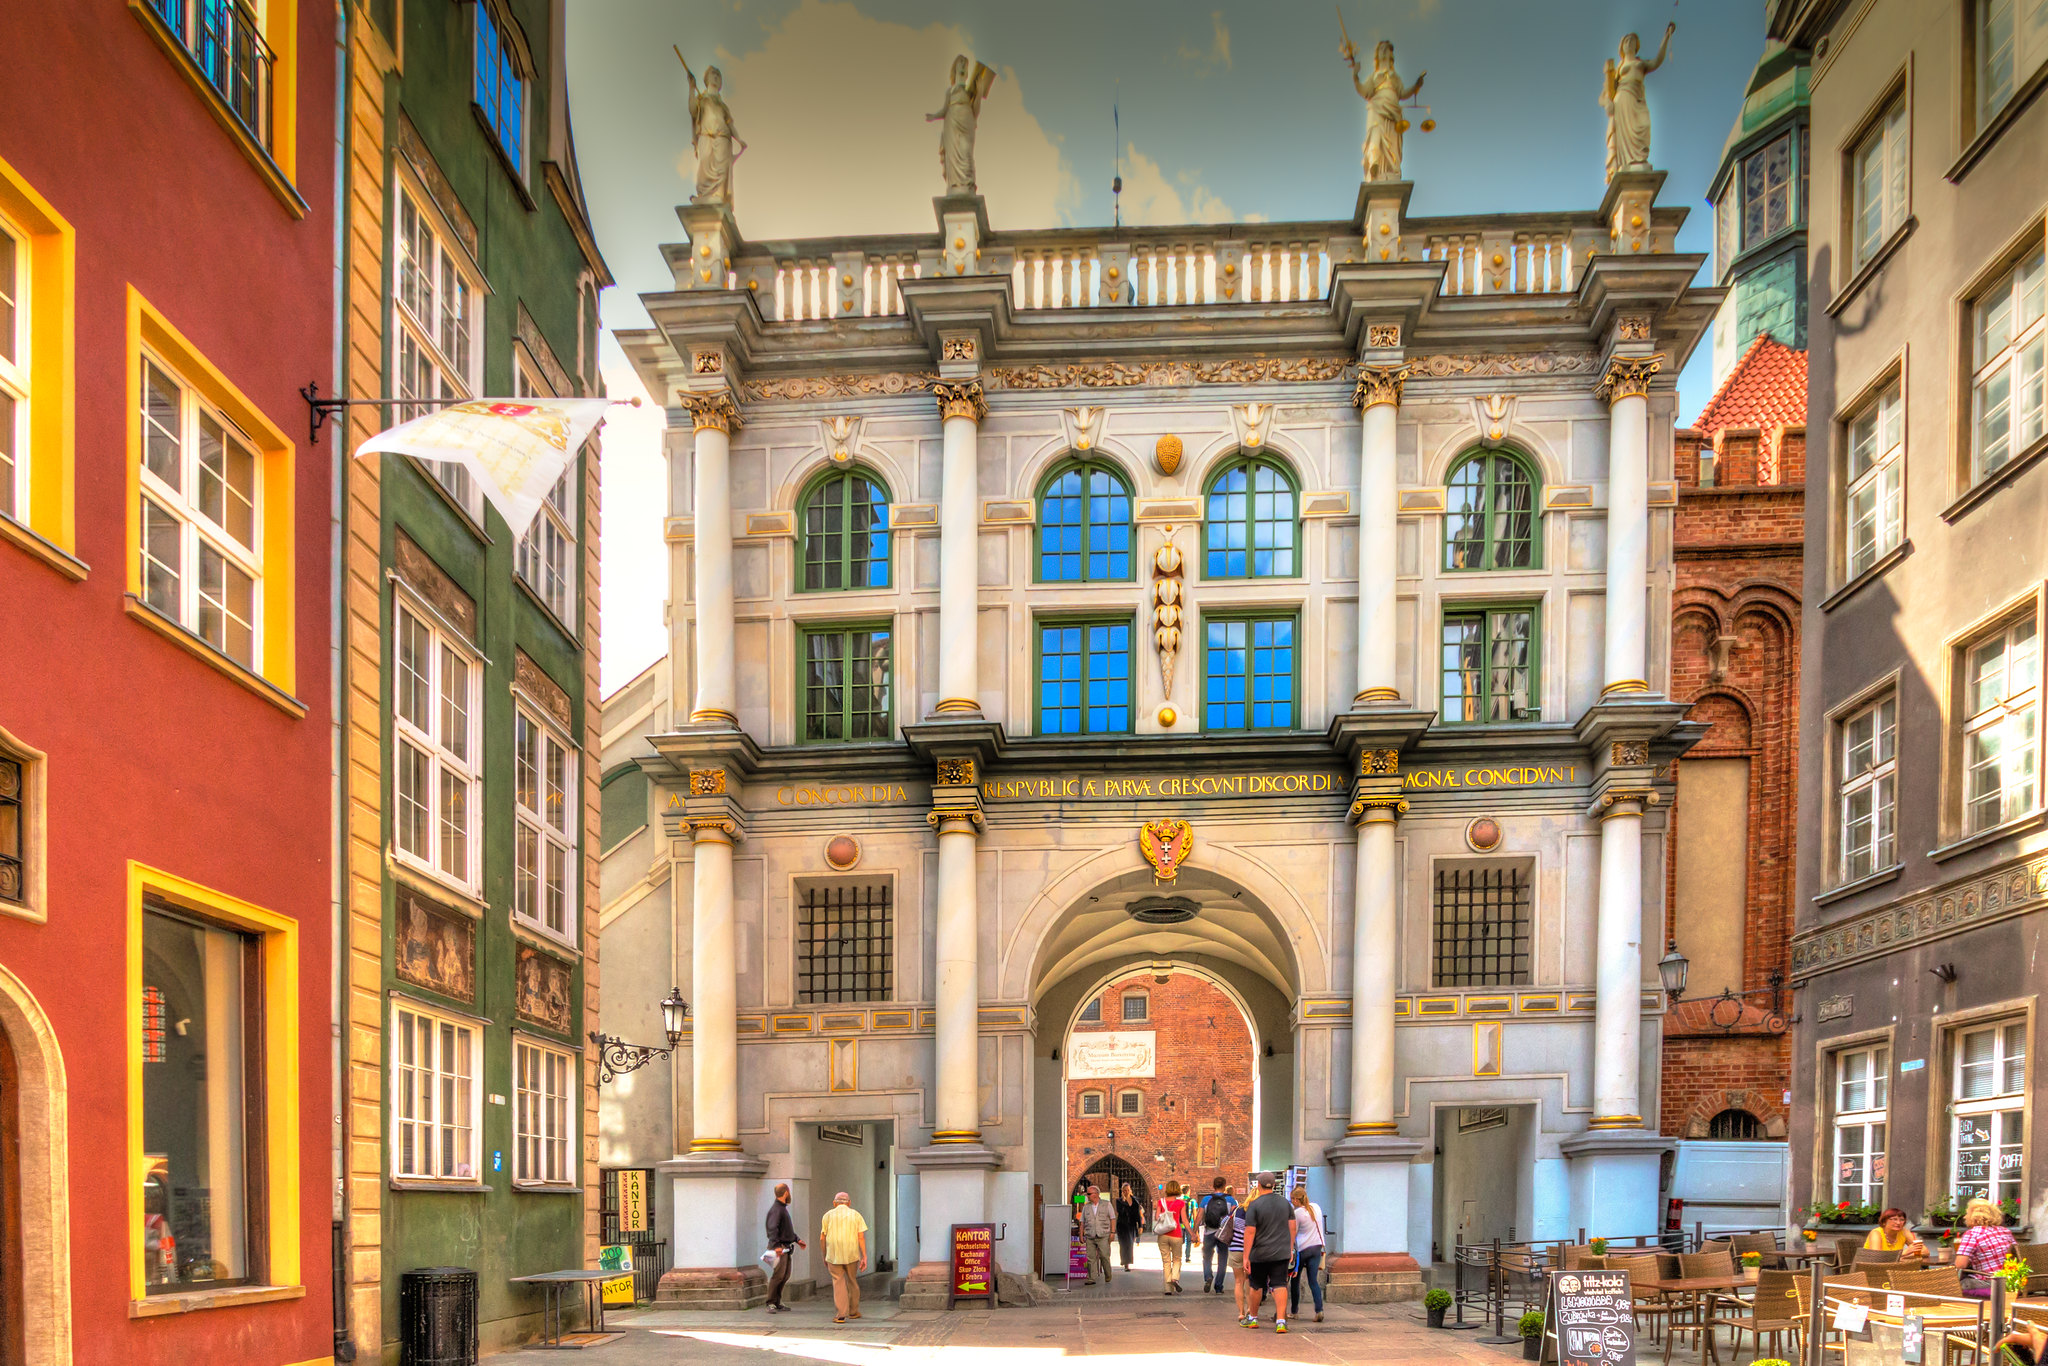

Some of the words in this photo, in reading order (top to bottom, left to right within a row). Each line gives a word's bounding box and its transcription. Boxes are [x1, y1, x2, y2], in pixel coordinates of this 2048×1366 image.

[777, 785, 907, 806] CONCORDIA
[1104, 779, 1156, 796] PARVÆ
[1158, 776, 1247, 796] CRESCVNT
[1401, 768, 1461, 788] AGNÆ
[1464, 765, 1580, 786] CONCIDVNT
[1959, 1164, 1984, 1177] BETTER
[1957, 1185, 1973, 1196] WITH
[630, 1171, 641, 1229] KANTOR
[956, 1231, 990, 1241] KANTOR
[1582, 1274, 1624, 1288] fritz-kola
